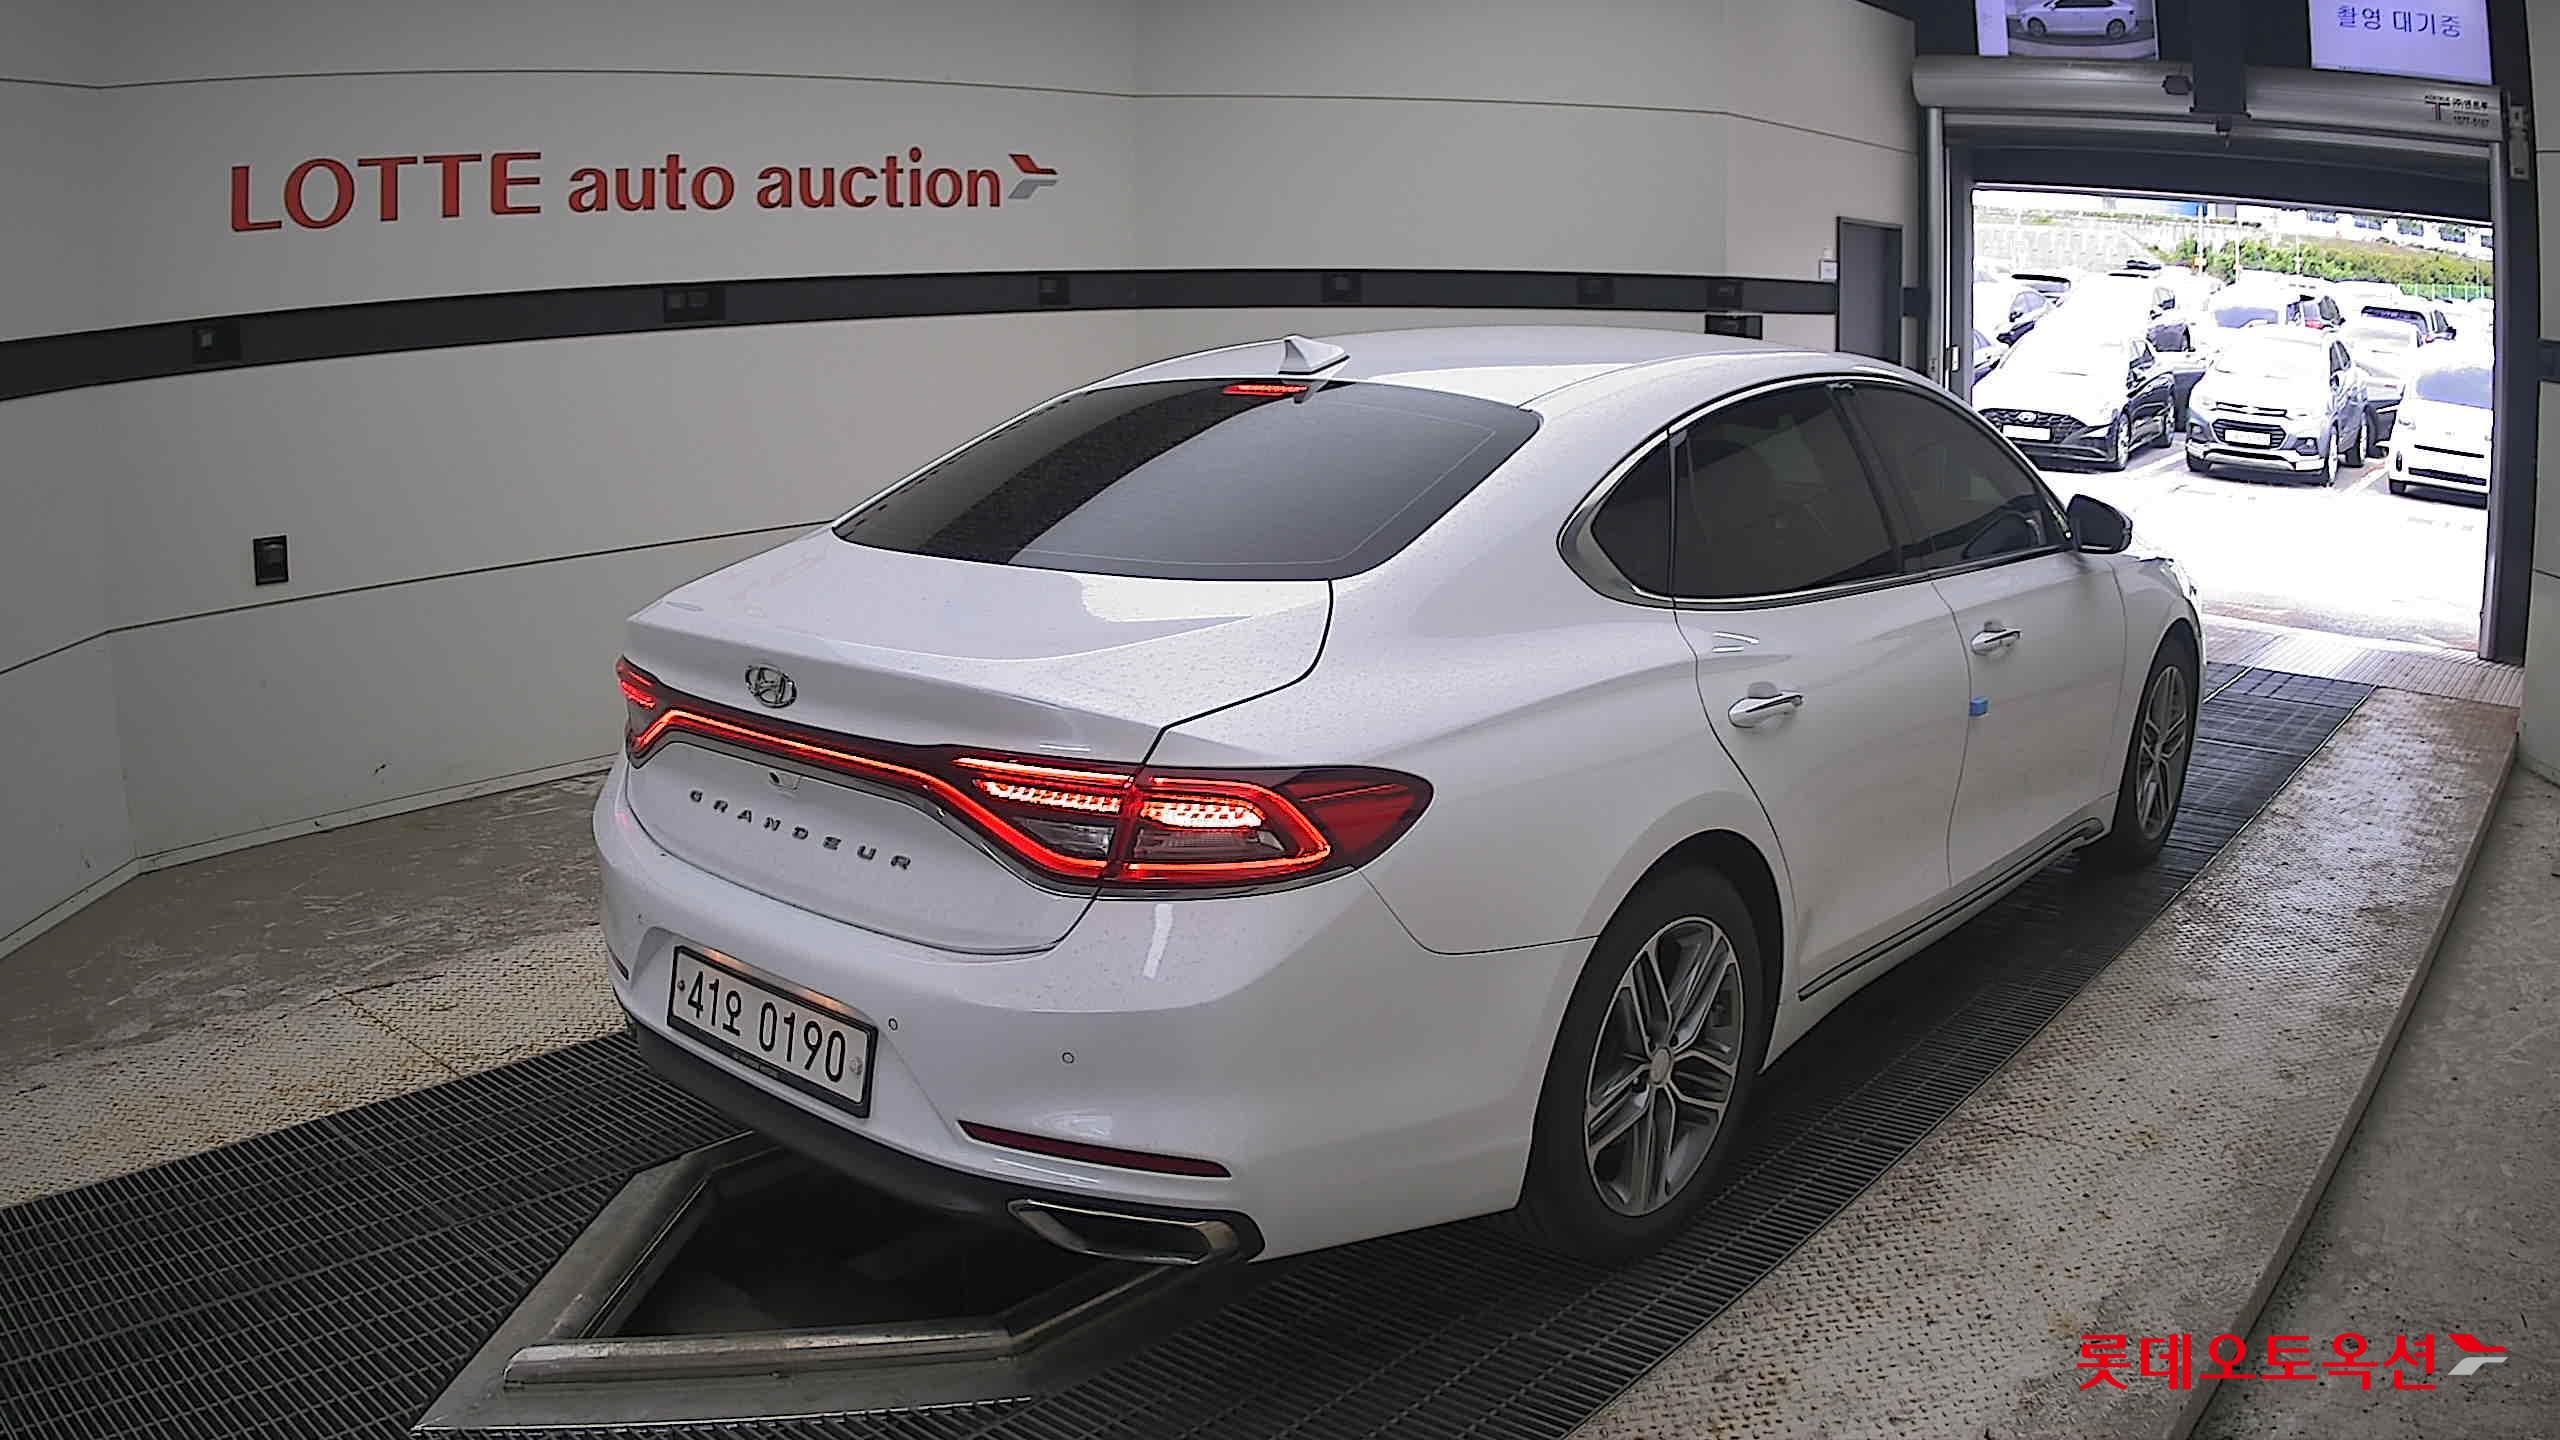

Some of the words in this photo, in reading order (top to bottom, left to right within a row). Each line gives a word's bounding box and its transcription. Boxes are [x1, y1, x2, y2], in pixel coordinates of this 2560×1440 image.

[2337, 5, 2381, 31] 촬영
[2393, 10, 2461, 38] 대기중
[231, 150, 543, 232] LOTTE
[567, 152, 735, 213] auto
[755, 146, 1003, 210] auction
[689, 789, 912, 871] GRANDEUR
[687, 970, 743, 1037] 41오
[758, 1001, 847, 1083] 0190
